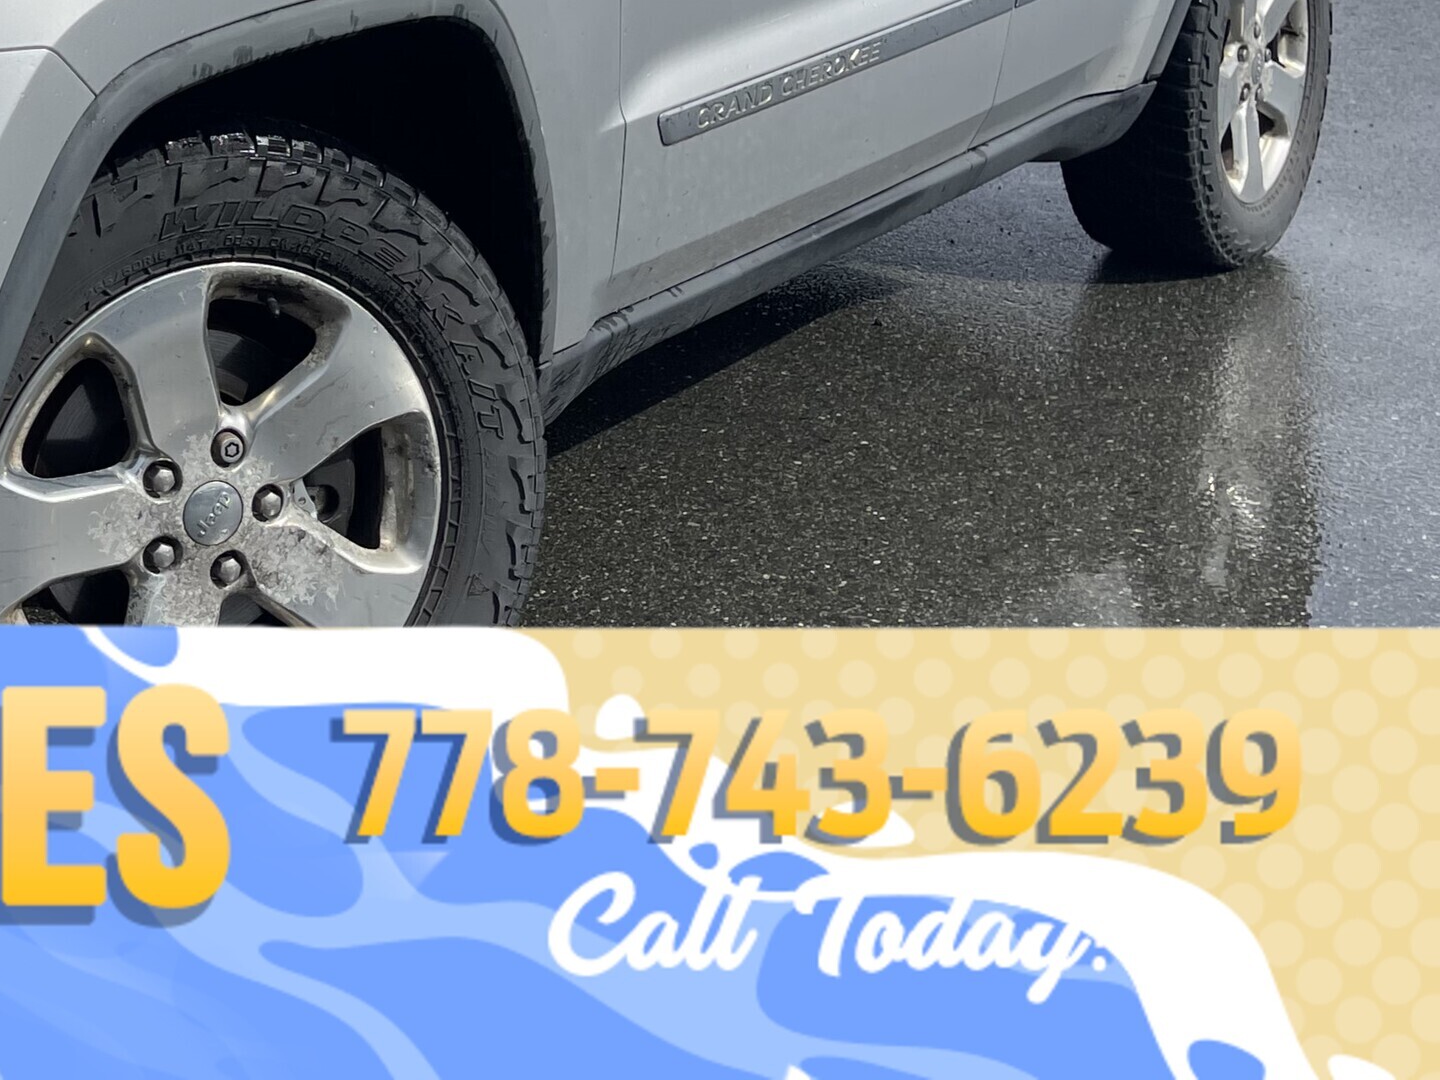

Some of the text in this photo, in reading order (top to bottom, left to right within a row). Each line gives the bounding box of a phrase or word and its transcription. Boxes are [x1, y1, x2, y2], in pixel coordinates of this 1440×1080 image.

[696, 41, 883, 130] GRAND CHEROKEE
[160, 200, 466, 333] WILDPEAK
[196, 491, 231, 537] Jeep
